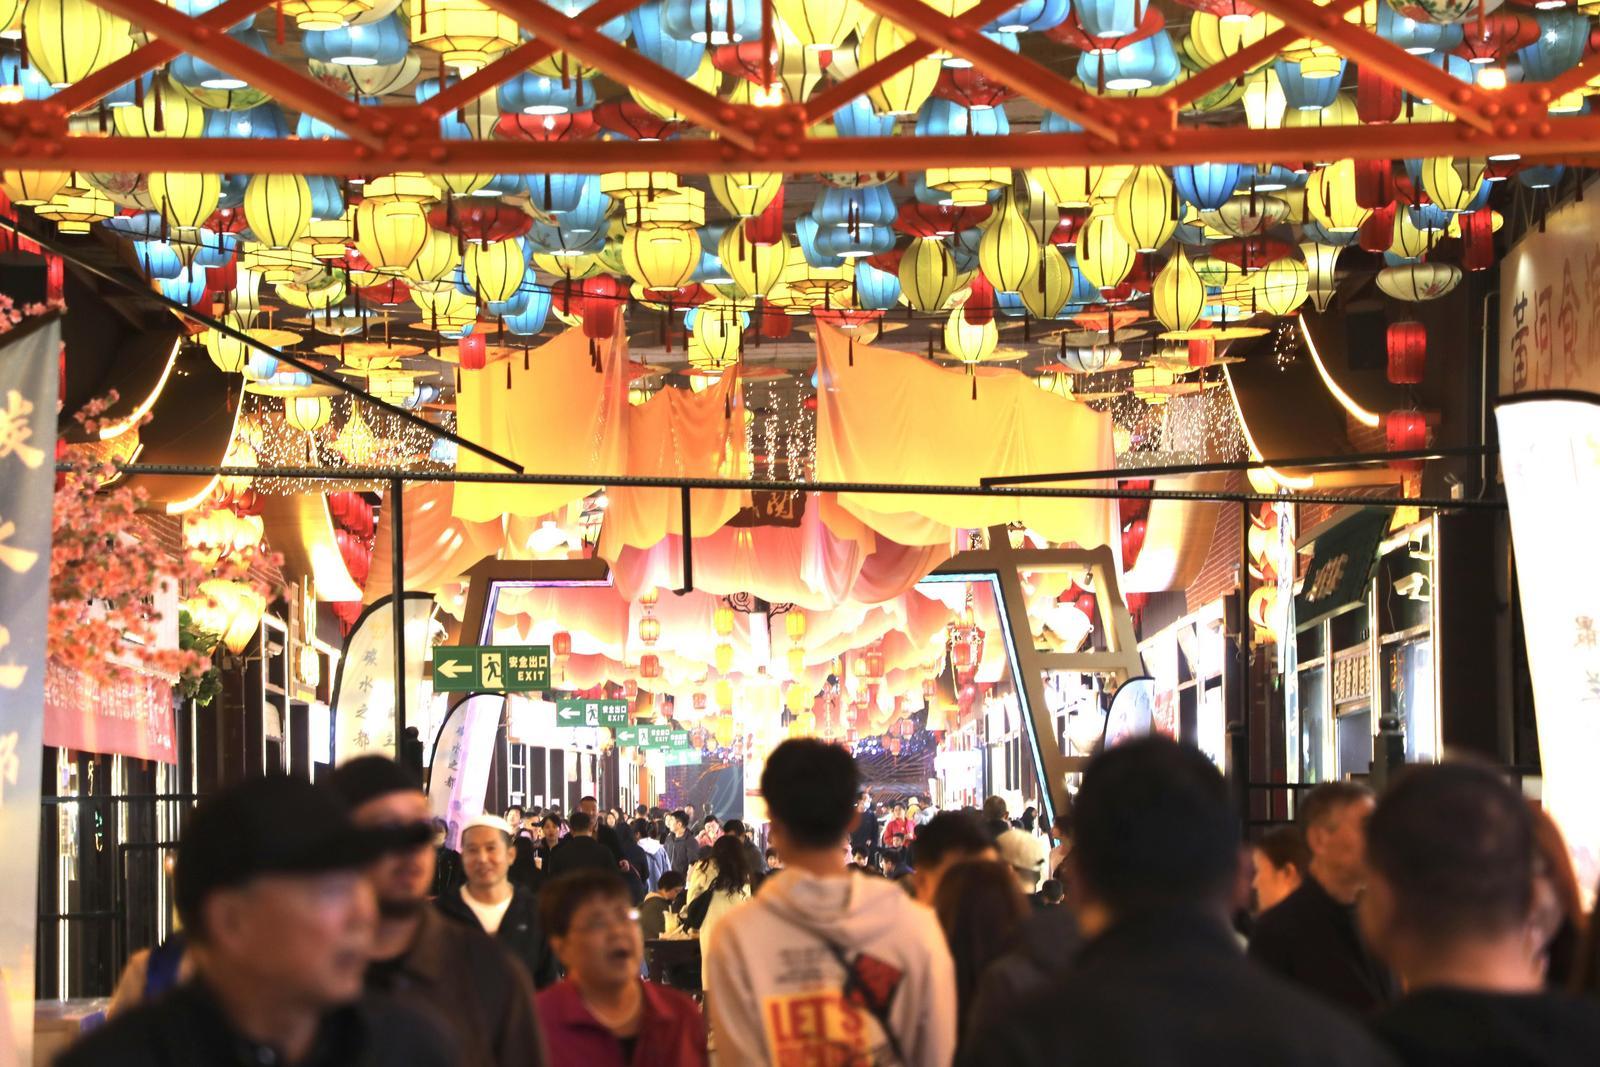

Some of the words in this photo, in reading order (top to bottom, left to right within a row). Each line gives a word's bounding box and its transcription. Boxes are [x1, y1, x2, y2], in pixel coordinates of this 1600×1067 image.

[508, 655, 547, 668] 安全出口
[517, 670, 545, 681] EXIT
[602, 704, 626, 714] 安全出口
[607, 714, 625, 722] EXIT
